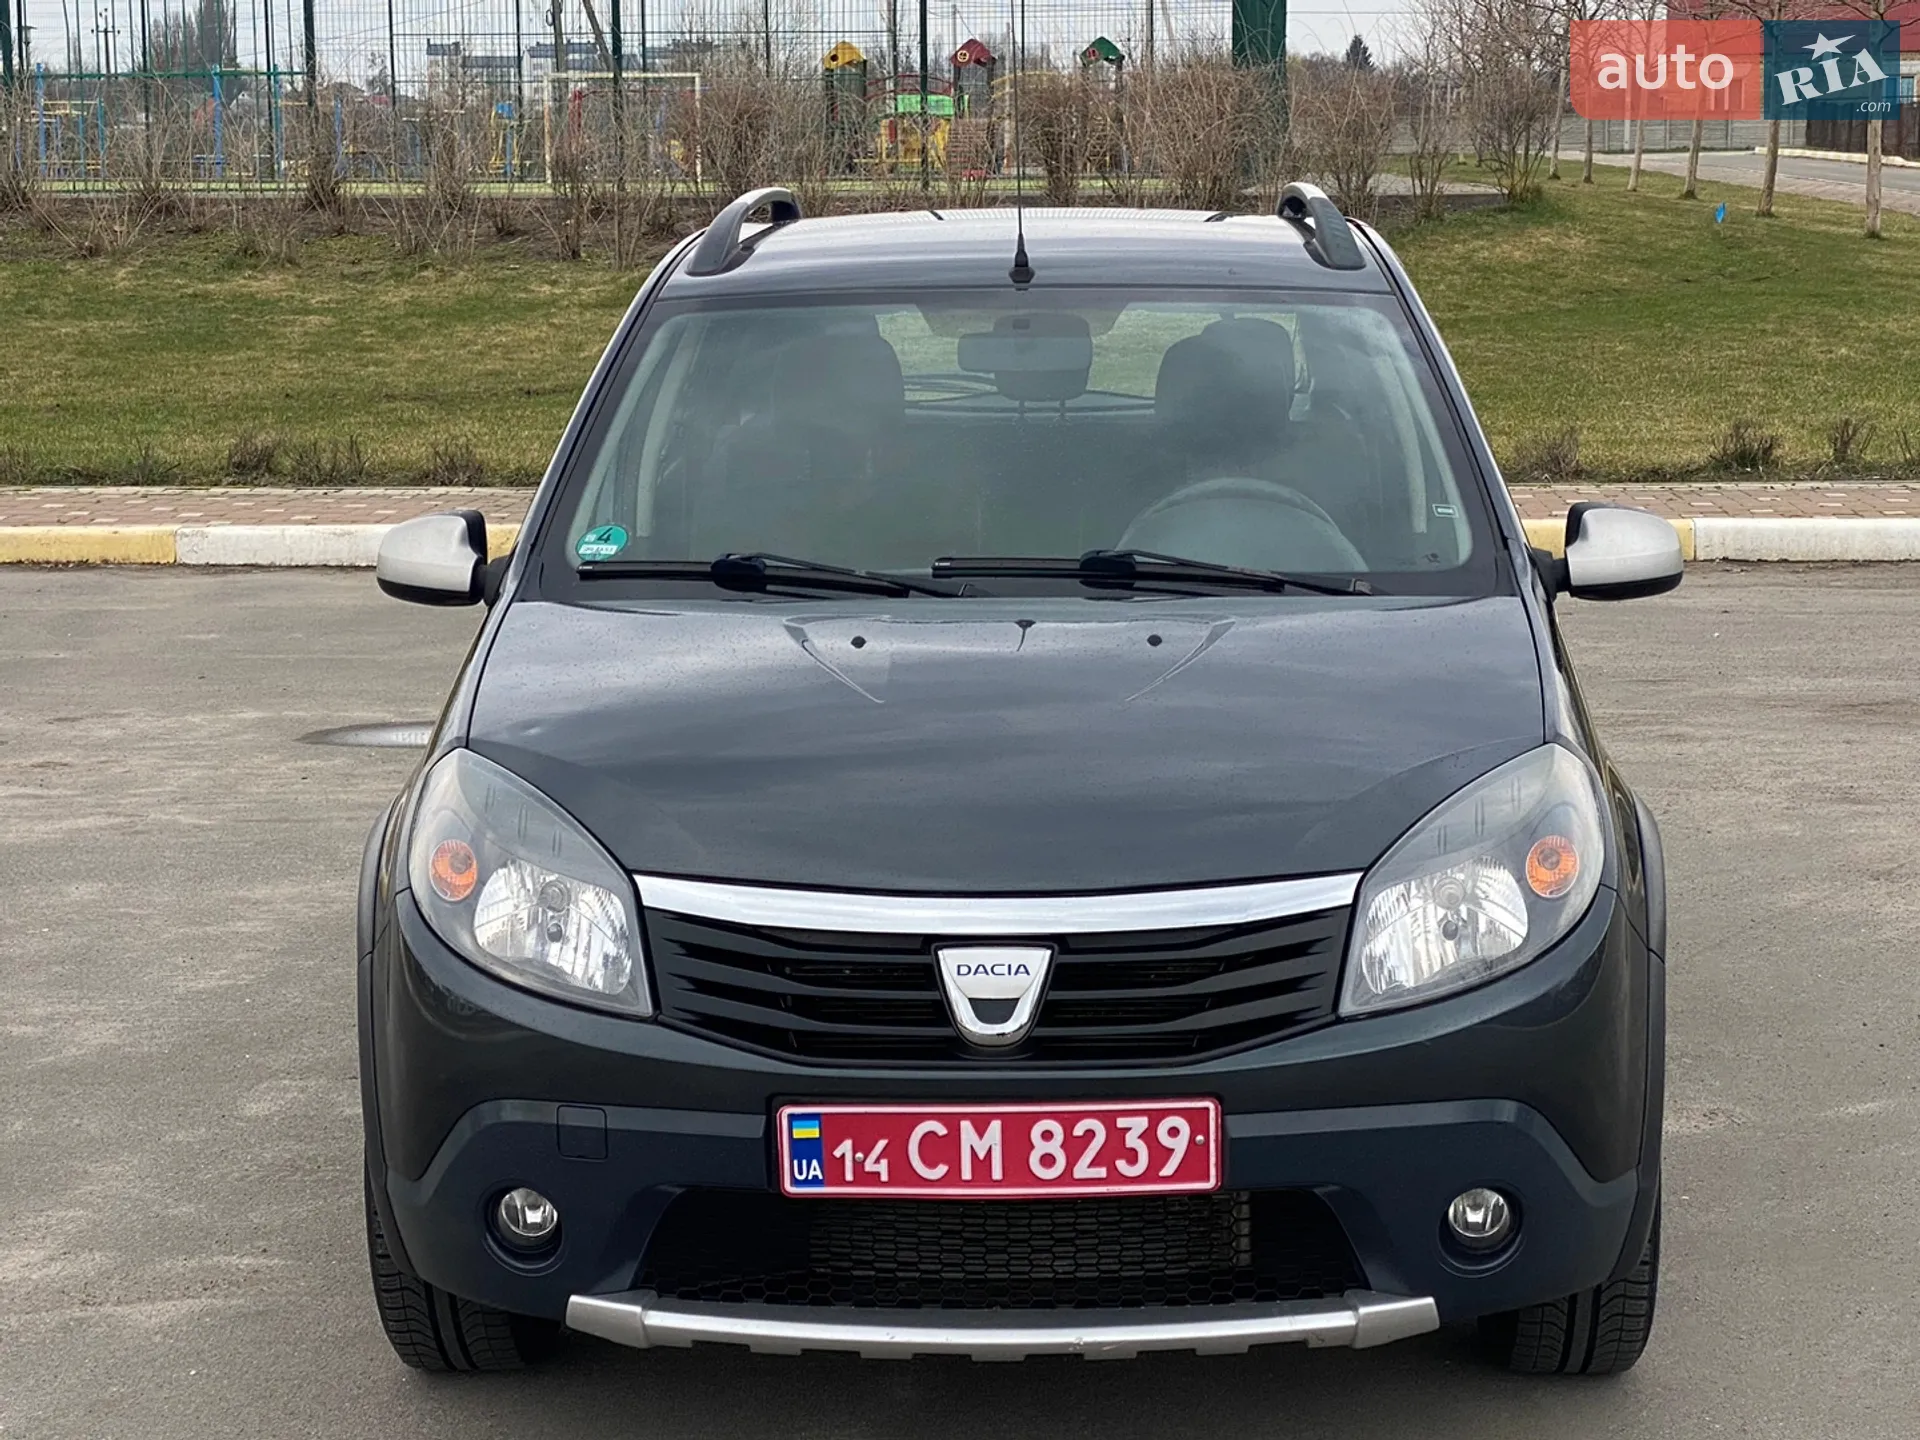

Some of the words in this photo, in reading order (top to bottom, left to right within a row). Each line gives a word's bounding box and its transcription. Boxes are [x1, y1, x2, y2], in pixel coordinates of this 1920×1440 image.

[597, 527, 613, 543] 4
[956, 963, 1031, 976] DACIA
[907, 1119, 1004, 1181] CM
[1028, 1116, 1191, 1181] 8239
[793, 1159, 823, 1181] UA
